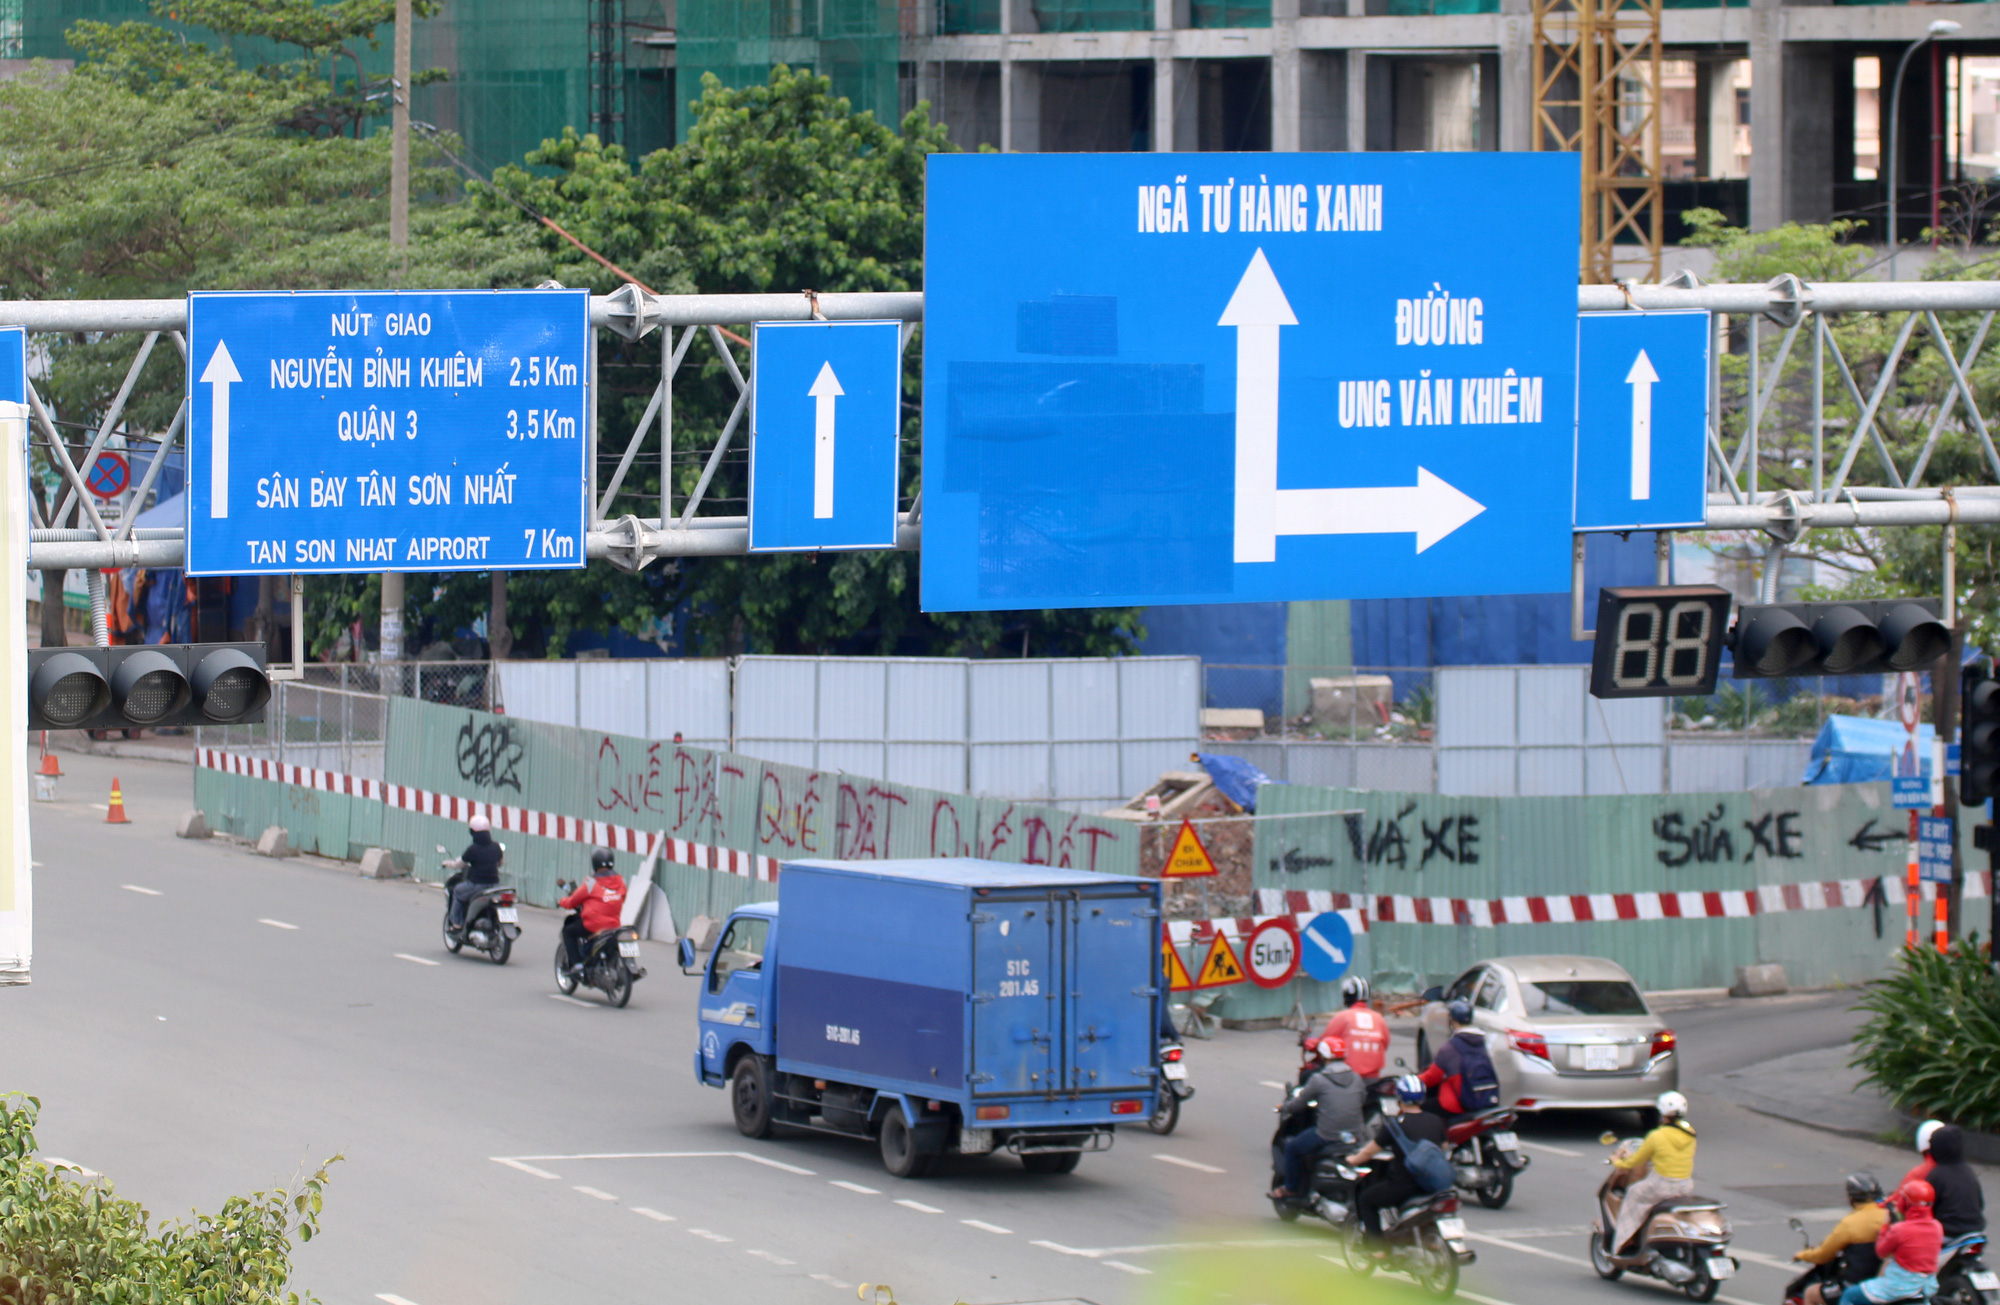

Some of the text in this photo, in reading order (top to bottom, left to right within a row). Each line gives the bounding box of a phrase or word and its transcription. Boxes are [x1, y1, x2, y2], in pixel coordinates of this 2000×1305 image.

[1138, 174, 1383, 233] NGÃ TƯ HÀNG XANH
[331, 306, 432, 337] NÚT GIAO
[1395, 282, 1484, 346] ĐƯỜNG
[270, 345, 483, 389] NGUYỄN BỈNH KHIÊM
[1338, 368, 1543, 428] UNG VĂN KHIÊM
[338, 404, 418, 447] QUẬN 3
[256, 461, 517, 509] SÂN BAY TÂN SƠN NHẤT
[246, 536, 491, 564] TAN SON NHAT AIPRORT
[1418, 816, 1479, 870] XE
[1743, 811, 1802, 864] XE
[1000, 980, 1039, 997] 201.45
[1007, 959, 1030, 976] 51C
